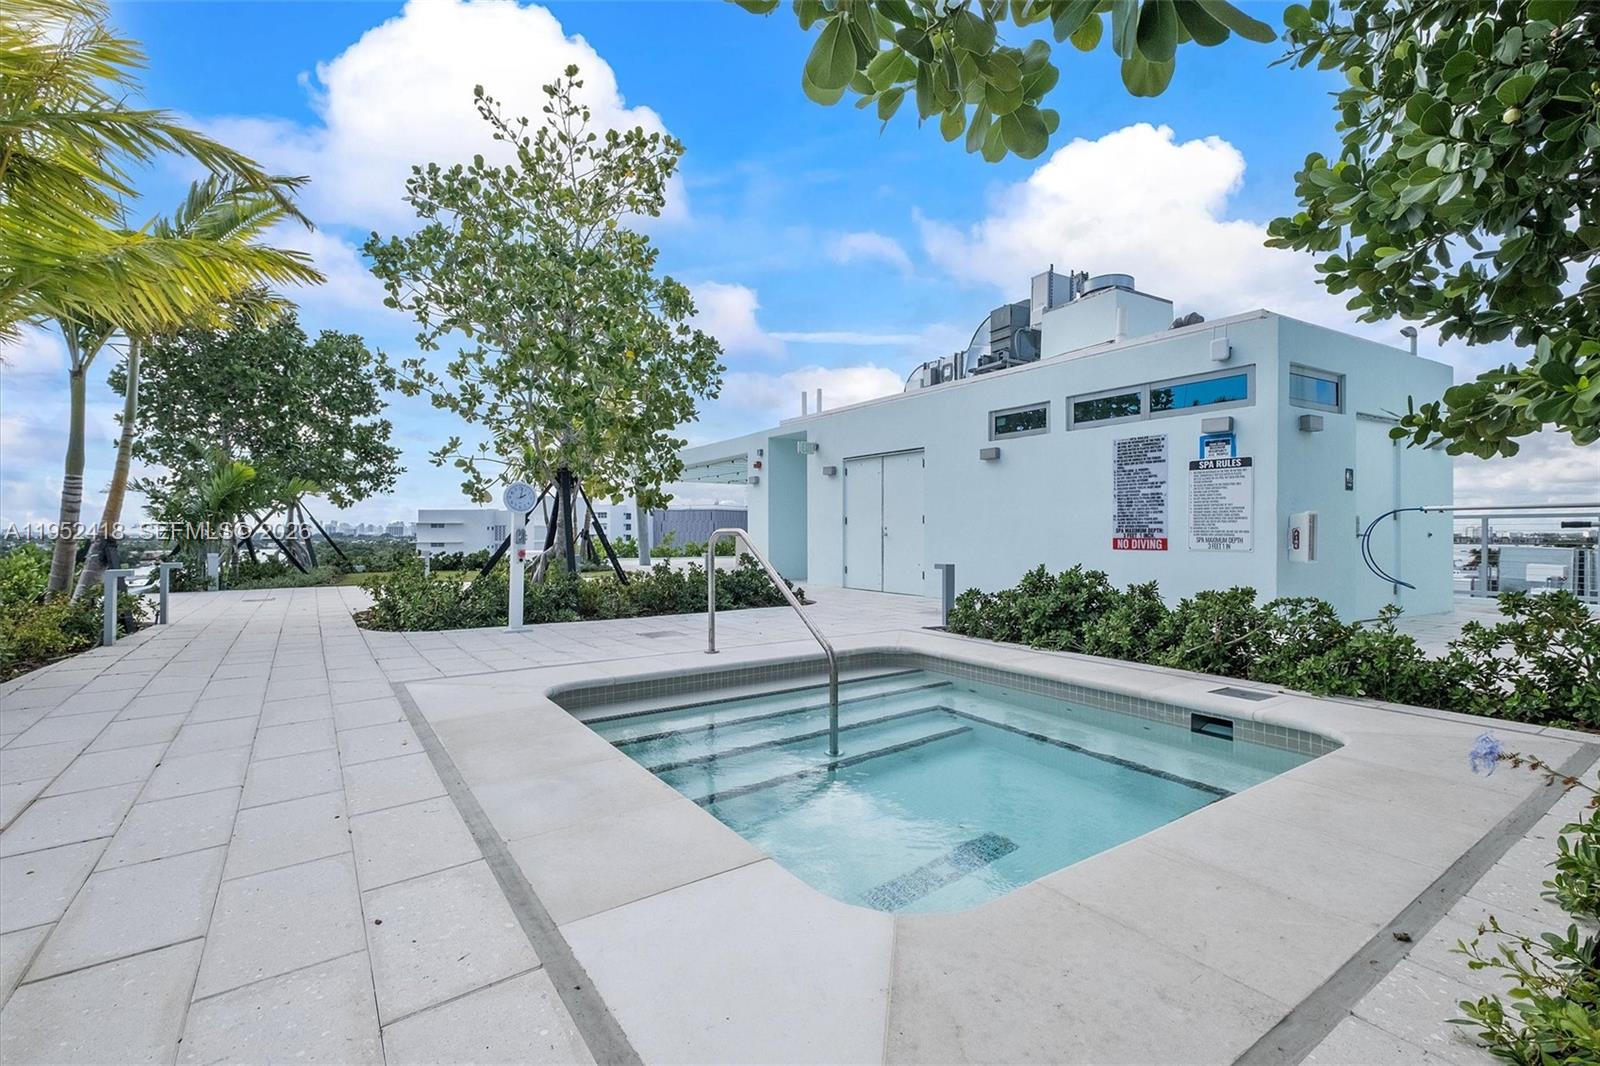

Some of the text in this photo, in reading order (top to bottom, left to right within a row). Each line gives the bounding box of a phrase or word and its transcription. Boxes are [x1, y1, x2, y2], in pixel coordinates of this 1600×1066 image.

[1198, 458, 1242, 469] SPA RULES
[1117, 539, 1163, 550] NO DIVING
